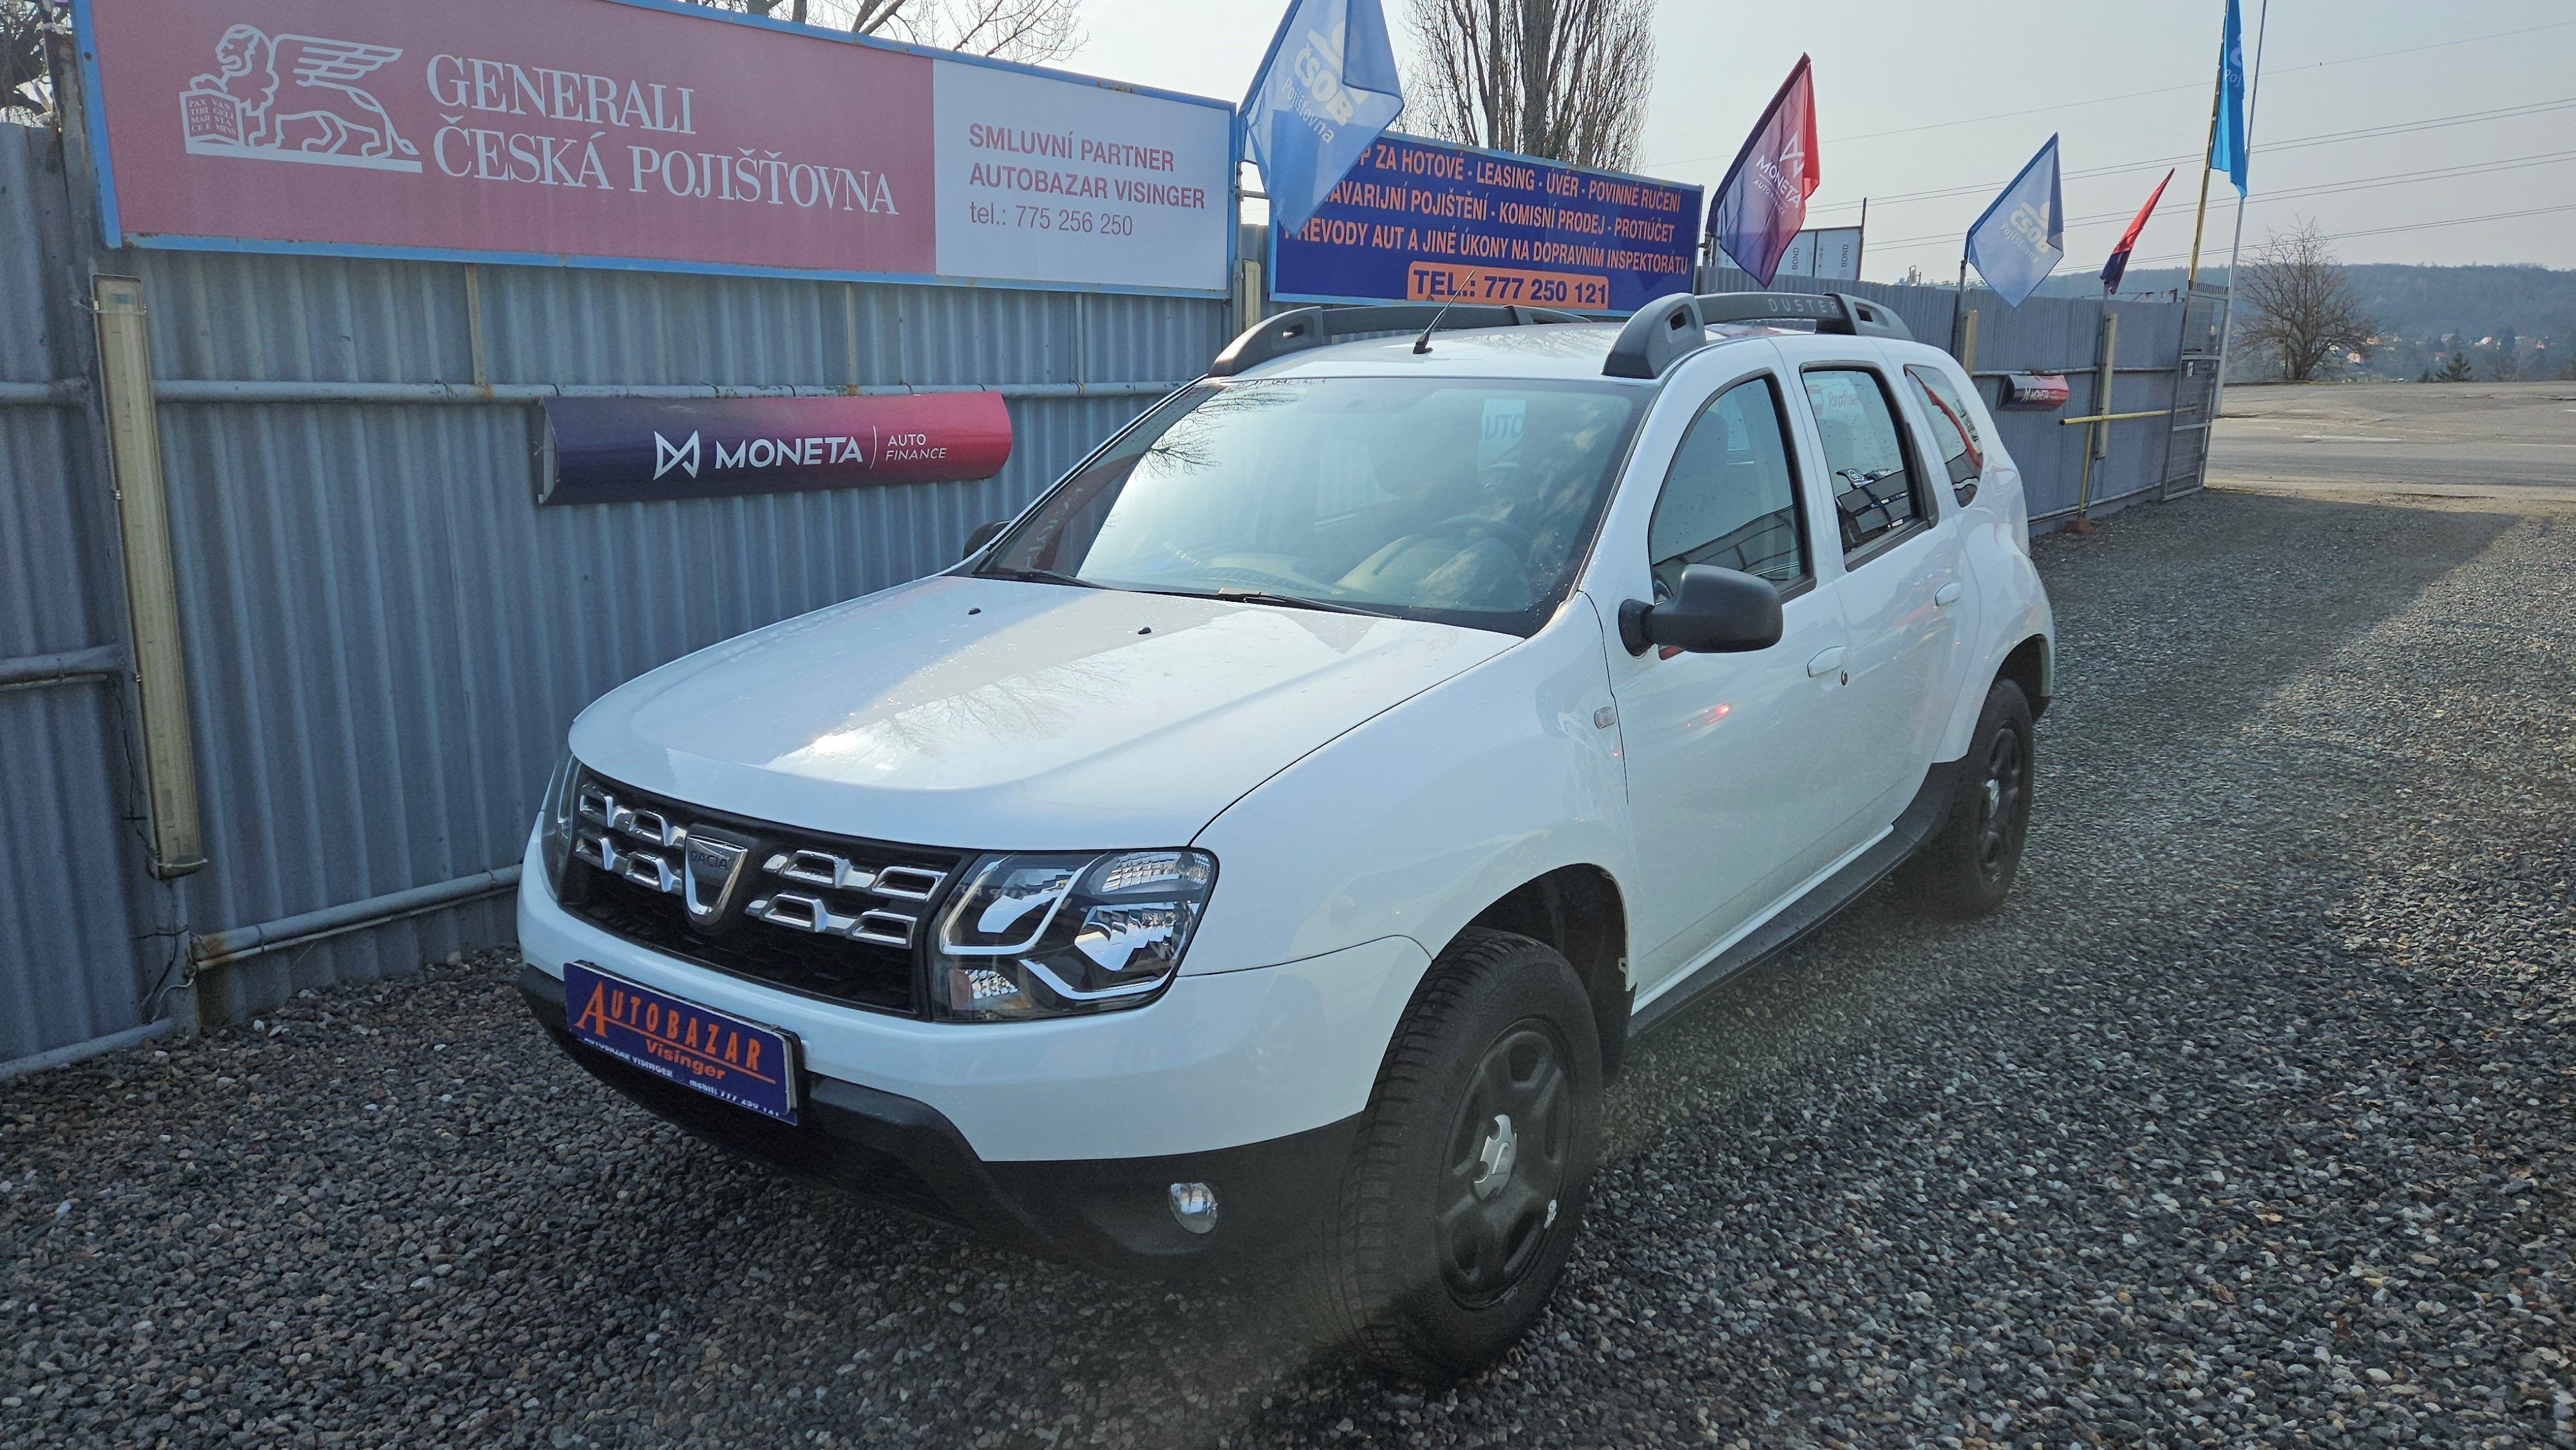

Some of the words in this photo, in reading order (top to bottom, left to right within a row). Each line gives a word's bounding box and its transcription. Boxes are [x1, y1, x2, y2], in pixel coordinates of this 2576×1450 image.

[426, 54, 696, 135] GENERALI
[1294, 42, 1354, 126] ČSOB
[1282, 77, 1334, 144] Pojišťovna
[433, 113, 614, 190] ČESKÁ
[627, 146, 899, 215] POJIŠŤOVNA
[969, 123, 1072, 159] SMLUVNÍ
[1081, 139, 1174, 172] PARTNER
[969, 162, 1108, 199] AUTOBAZAR
[1114, 179, 1205, 209] VISINGER
[1376, 144, 1397, 171] ZA
[1402, 149, 1464, 181] HOTOVÉ
[1476, 161, 1535, 191] LEASING
[1546, 167, 1578, 198] ÚVĚR
[1589, 180, 1639, 206] POVINNÉ
[1641, 186, 1682, 213] RUČENÍ
[1753, 180, 1770, 195] AUTO
[1756, 154, 1801, 208] MONETA
[969, 202, 1006, 225] tel.:
[1016, 205, 1050, 229] 775
[1059, 209, 1093, 232] 256
[1100, 213, 1133, 236] 250
[1325, 180, 1408, 211] AVARIJNÍ
[1411, 187, 1489, 221] POJIŠTĚNÍ
[1499, 202, 1557, 229] KOMISNÍ
[1558, 210, 1605, 234] PRODEJ
[1614, 216, 1675, 243] PROTIÚČET
[1285, 218, 1368, 246] EVODY
[1372, 225, 1405, 249] AUT
[1408, 228, 1418, 251] A
[1423, 225, 1456, 254] JINÉ
[1461, 227, 1508, 258] ÚKONY
[1511, 239, 1529, 261] NA
[1533, 241, 1604, 267] DOPRAVNÍM
[1607, 249, 1689, 276] INSPEKTORÁTU
[1414, 270, 1475, 297] TEL.:
[1484, 276, 1524, 299] 777
[1530, 278, 1567, 302] 250
[1575, 282, 1605, 304] 121
[1768, 298, 1839, 314] DUSTER
[715, 436, 863, 469] MONETA
[886, 447, 947, 461] FINANCE
[887, 433, 926, 446] AUTO
[690, 851, 727, 869] DACIA
[646, 1039, 726, 1079] Visinger
